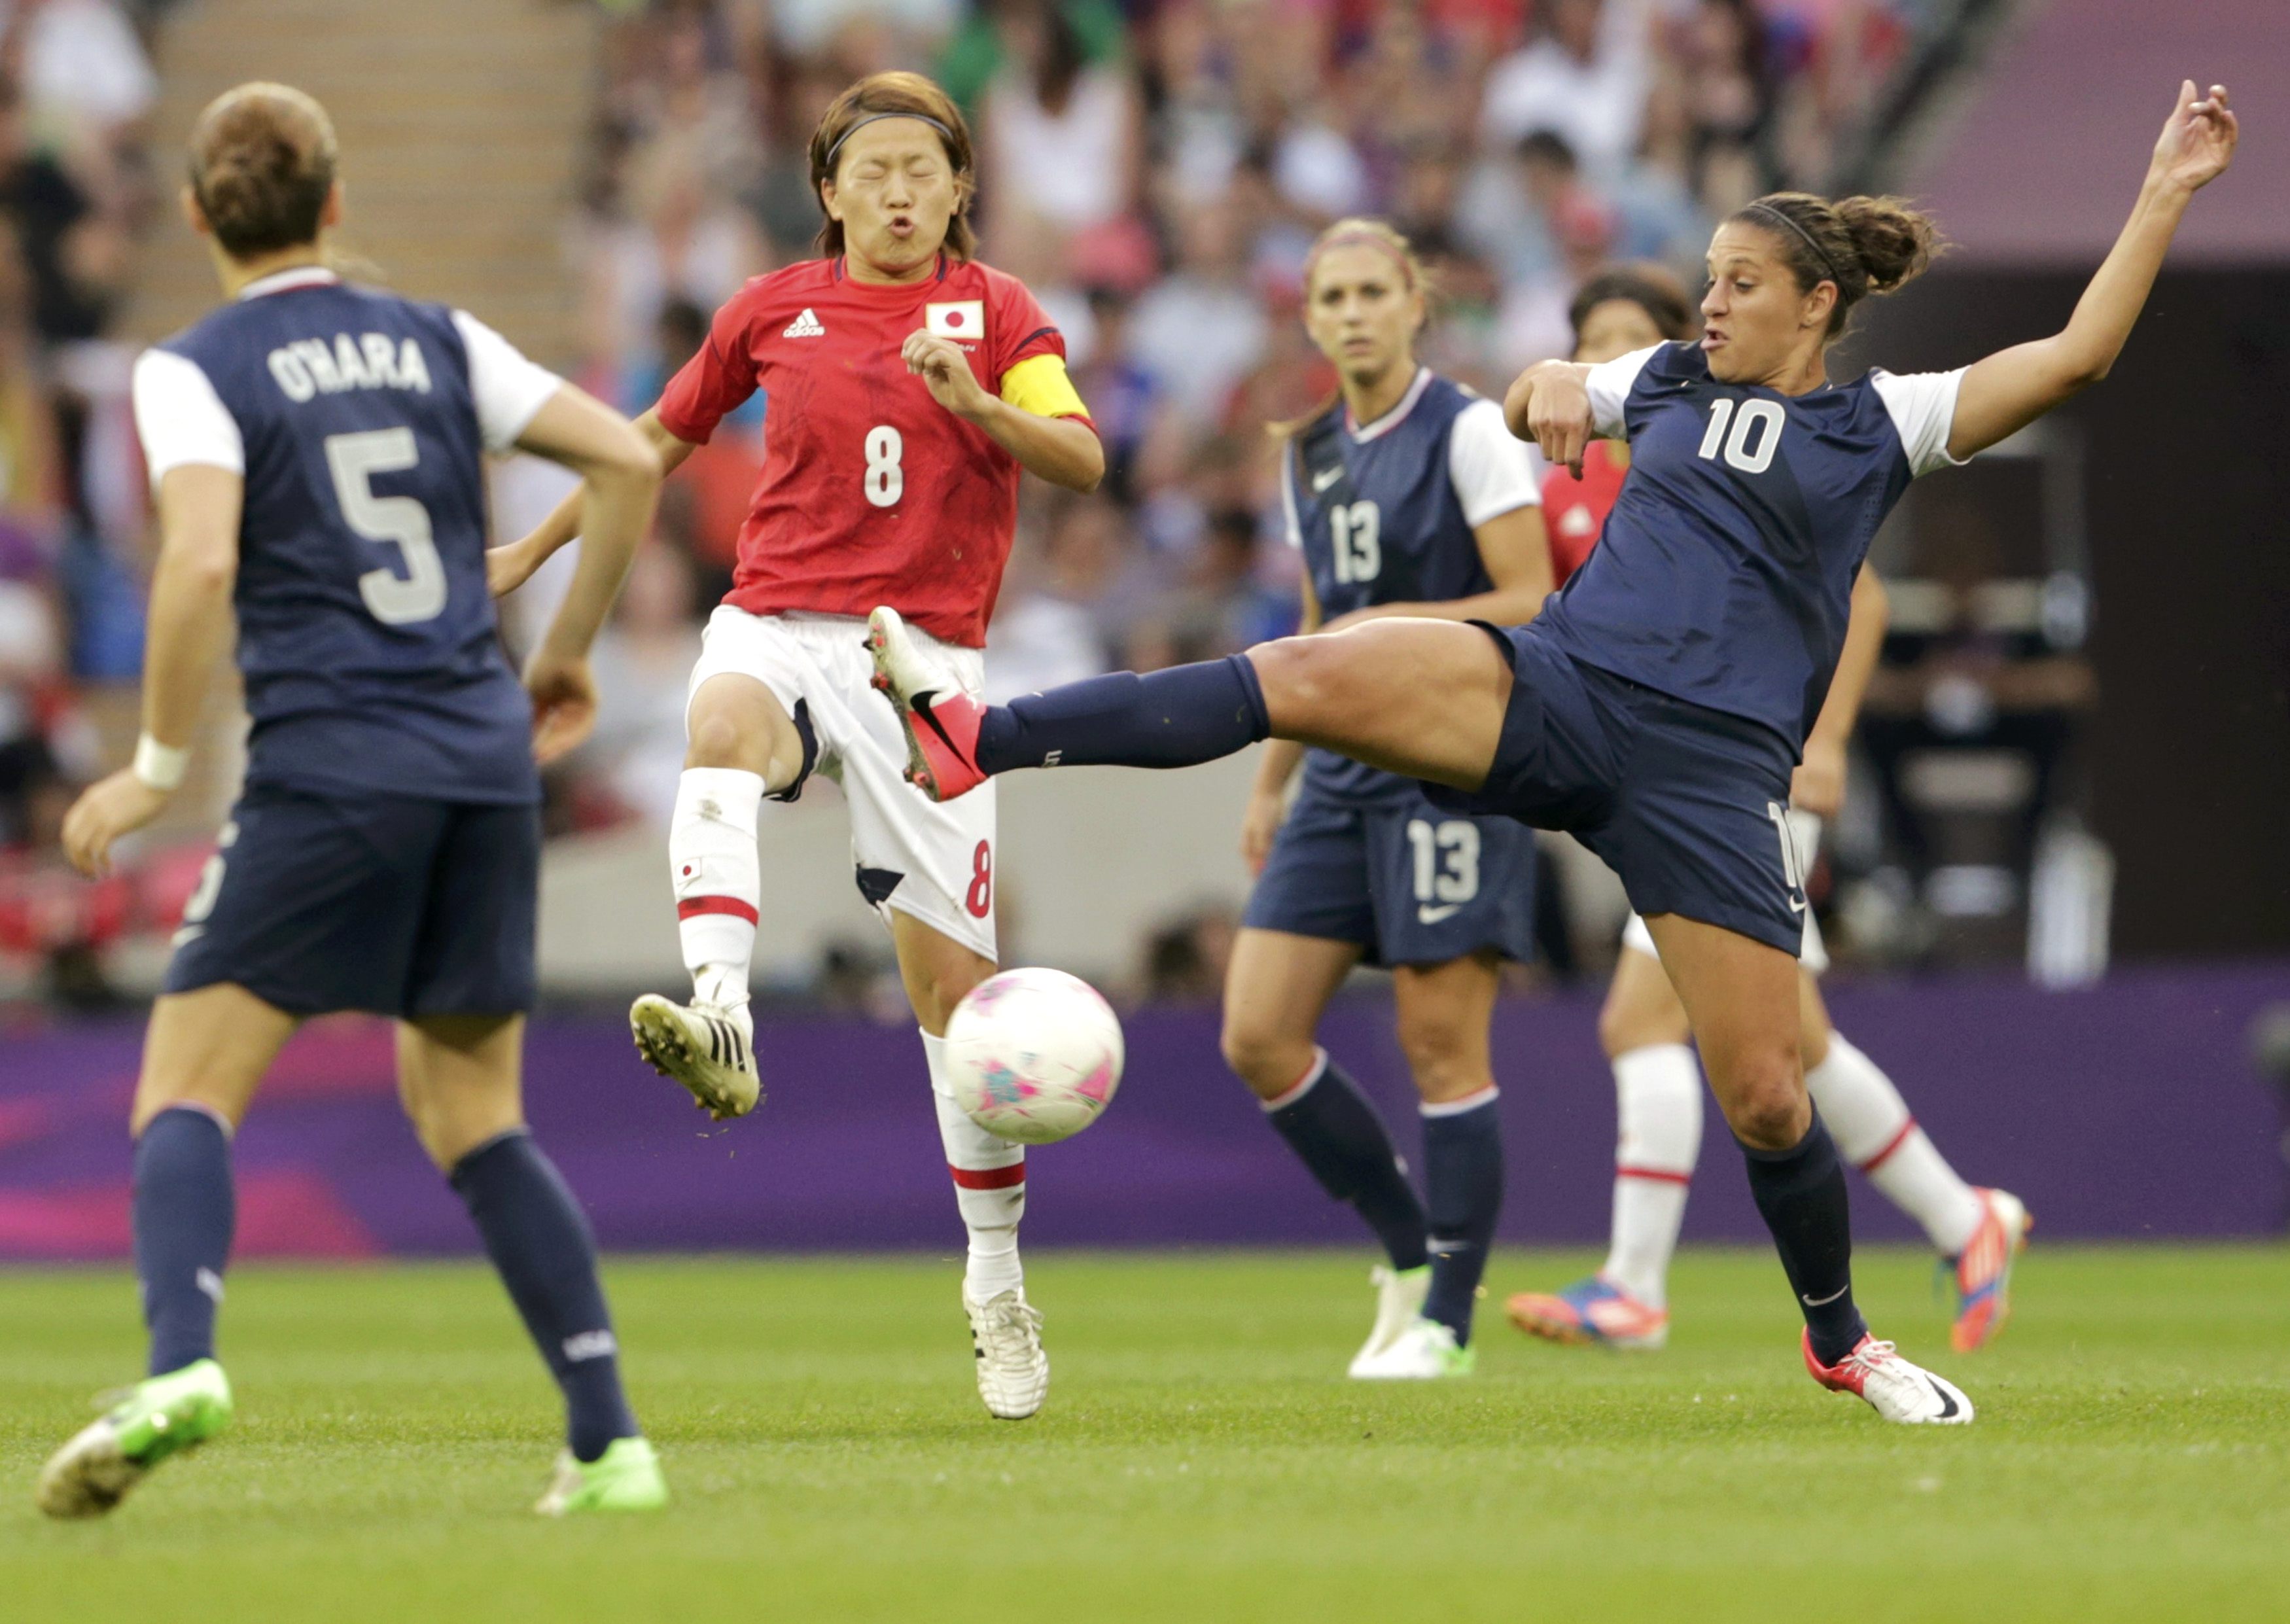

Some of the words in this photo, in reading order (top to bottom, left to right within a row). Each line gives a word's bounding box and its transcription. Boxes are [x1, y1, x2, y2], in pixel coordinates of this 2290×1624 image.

[267, 332, 432, 403] O'HARA
[783, 326, 826, 338] adidas
[864, 425, 903, 507] 8
[1698, 398, 1786, 474] 10
[324, 426, 448, 626] 5
[1331, 500, 1381, 583] 13
[965, 839, 991, 919] 8
[1407, 819, 1481, 902] 13
